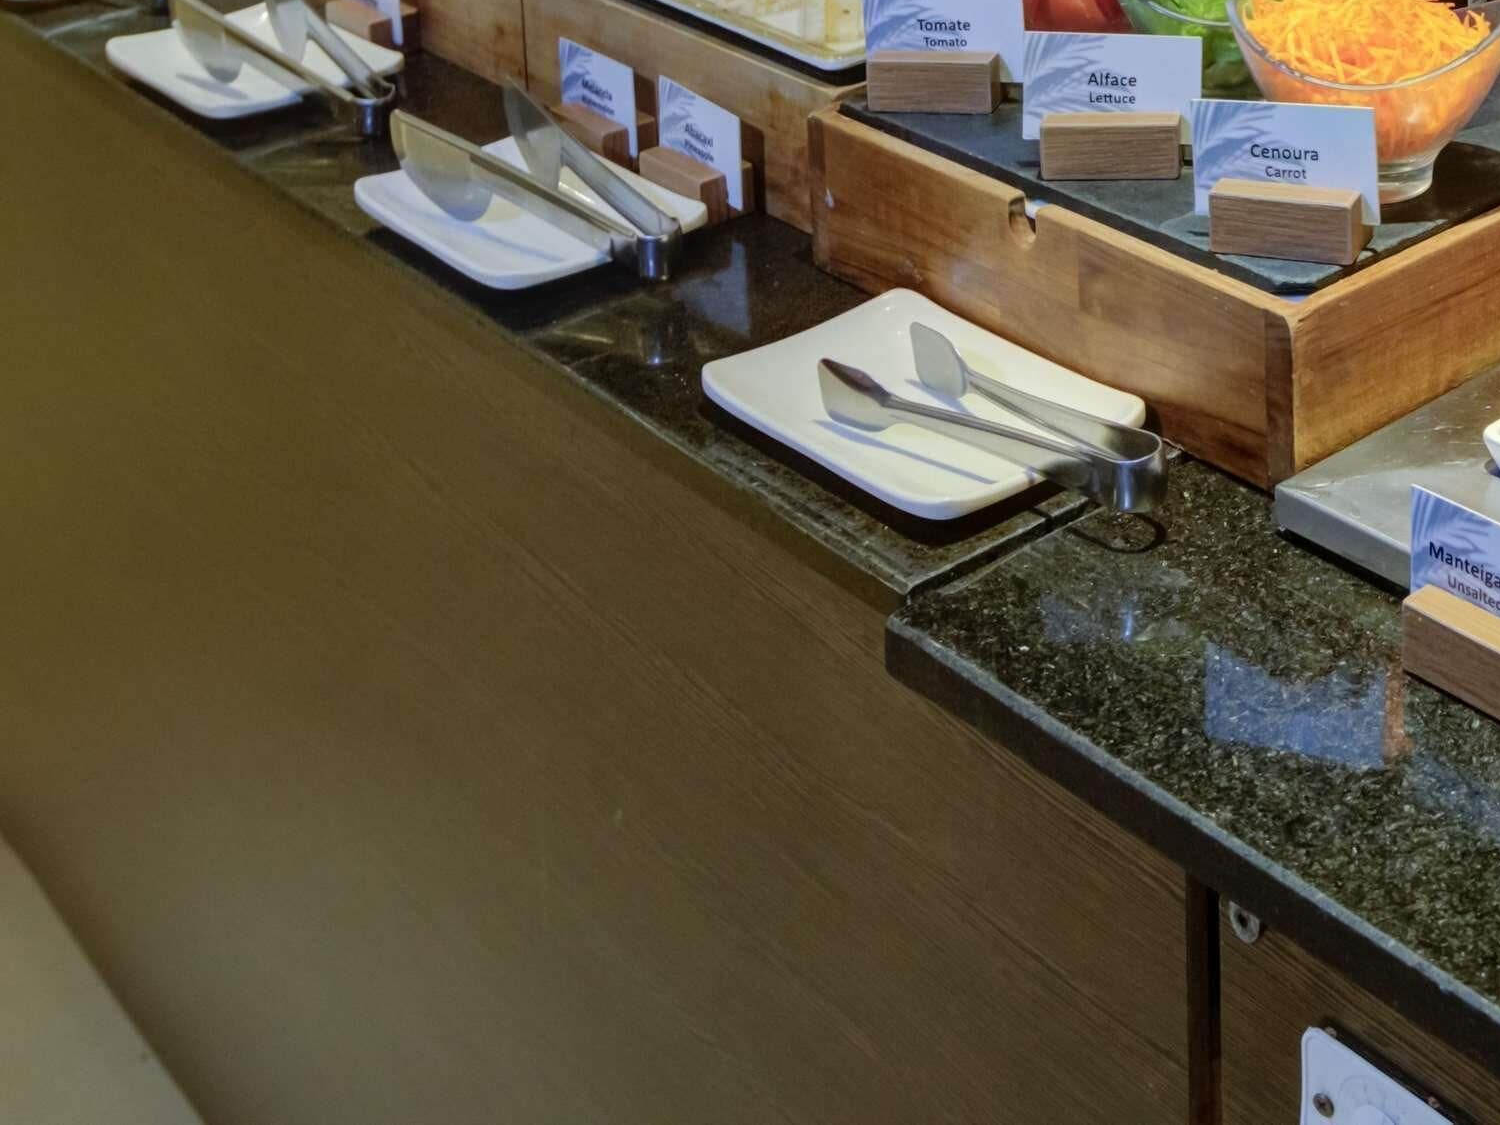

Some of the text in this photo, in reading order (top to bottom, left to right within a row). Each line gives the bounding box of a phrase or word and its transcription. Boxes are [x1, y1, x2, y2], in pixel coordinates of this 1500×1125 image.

[917, 19, 971, 33] Tomate
[923, 37, 968, 48] Tomato
[1088, 72, 1137, 87] Alface
[1089, 92, 1136, 105] Lettuce
[1250, 143, 1319, 162] Cenoura
[1265, 166, 1307, 180] Carrot
